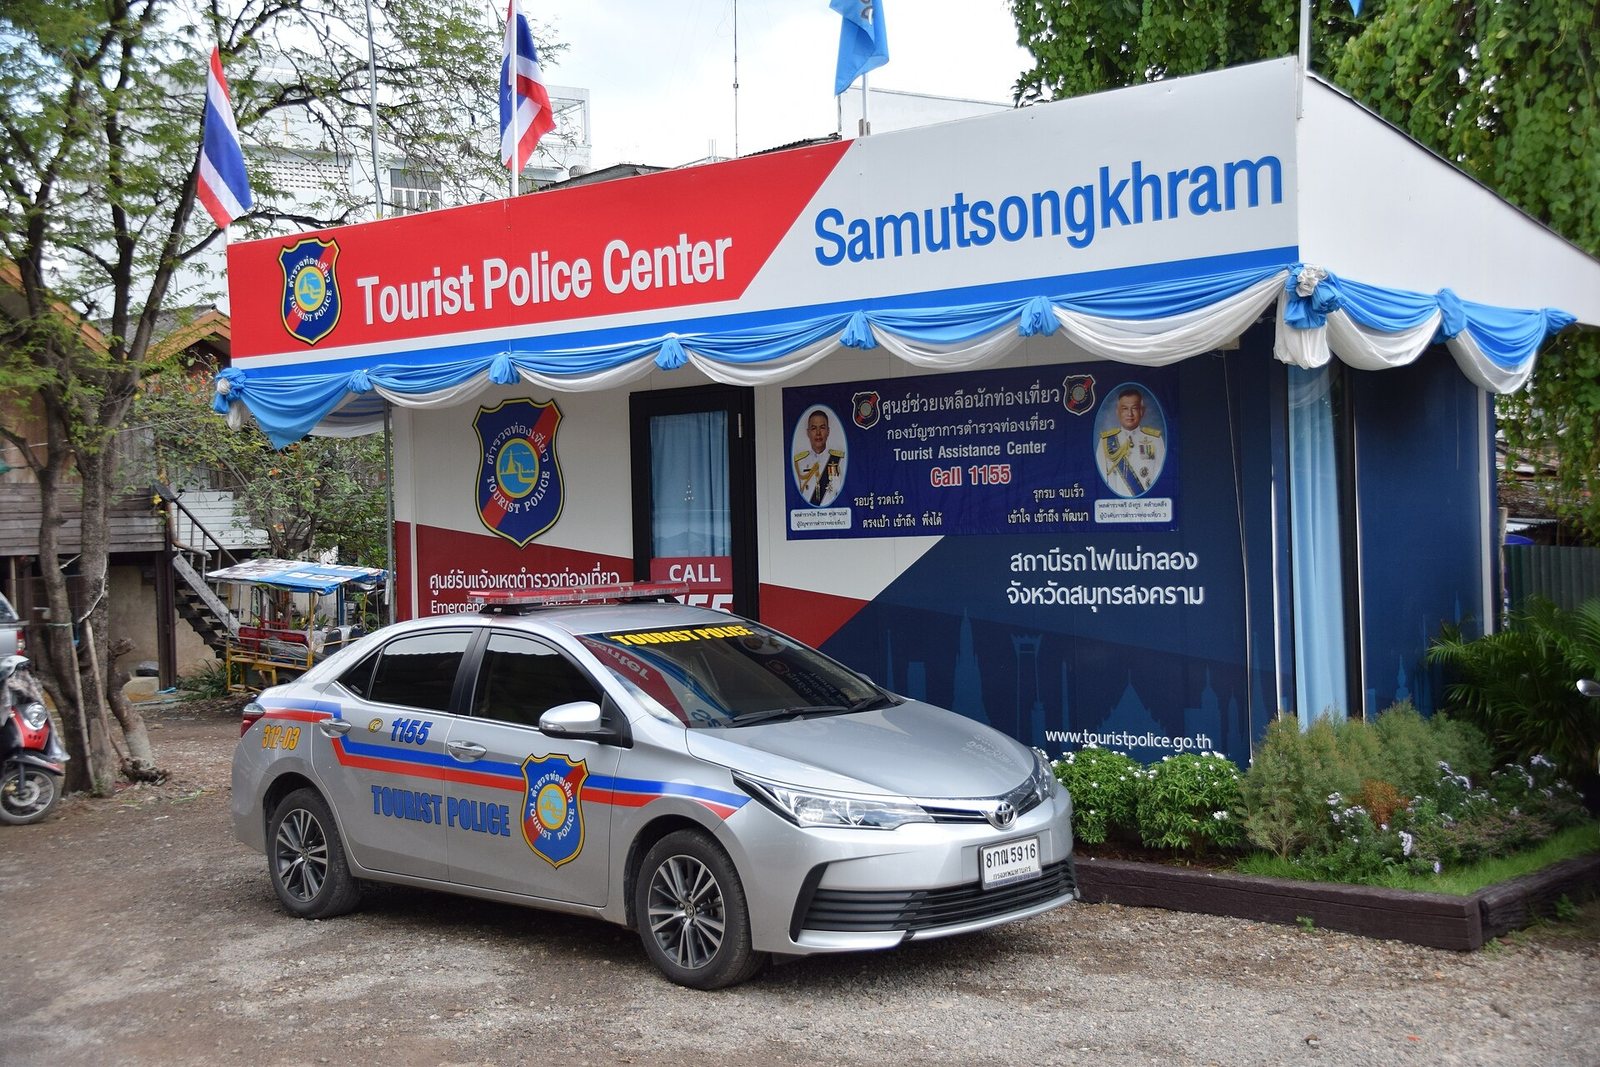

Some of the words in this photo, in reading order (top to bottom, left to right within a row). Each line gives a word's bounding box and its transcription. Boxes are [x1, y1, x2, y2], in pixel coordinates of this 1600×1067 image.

[814, 155, 1283, 267] Samutsongkhram
[357, 265, 475, 325] Tourist
[483, 251, 592, 310] Police
[603, 234, 732, 295] Center
[289, 294, 313, 321] TOURIST
[315, 290, 333, 320] POLICE
[882, 380, 1061, 421] ศูนย์ช่วยเหลือนักท่องเที่ยว
[887, 412, 1055, 441] กองบัญชาการตำรวจท่องเที่ยว
[486, 422, 549, 465] ตำรวจท่องเที่ยว
[894, 446, 933, 461] Tourist
[938, 444, 1000, 458] Assistance
[1007, 441, 1047, 455] Center
[930, 466, 962, 487] Call
[968, 464, 1011, 485] 1155
[487, 476, 520, 513] TOURIST
[524, 471, 550, 512] POLICE
[669, 564, 721, 583] CALL
[1010, 546, 1198, 571] สถานีรถไฟแม่กลอง
[429, 562, 620, 595] ศูนย์รับแจ้งเหตตำรวจท่องเที่ยว
[1006, 580, 1205, 613] จังหวัดสมุทรสงคราม
[610, 630, 700, 646] TOURIST
[693, 625, 754, 640] POLICE
[262, 724, 301, 750] 312-03
[391, 717, 433, 746] 1155
[1045, 729, 1212, 752] www.touristpolice.go.th
[371, 785, 442, 825] TOURIST
[447, 797, 511, 837] POLICE
[529, 802, 552, 840] TOURIST
[557, 808, 575, 840] POLICE
[1010, 843, 1036, 863] 5916
